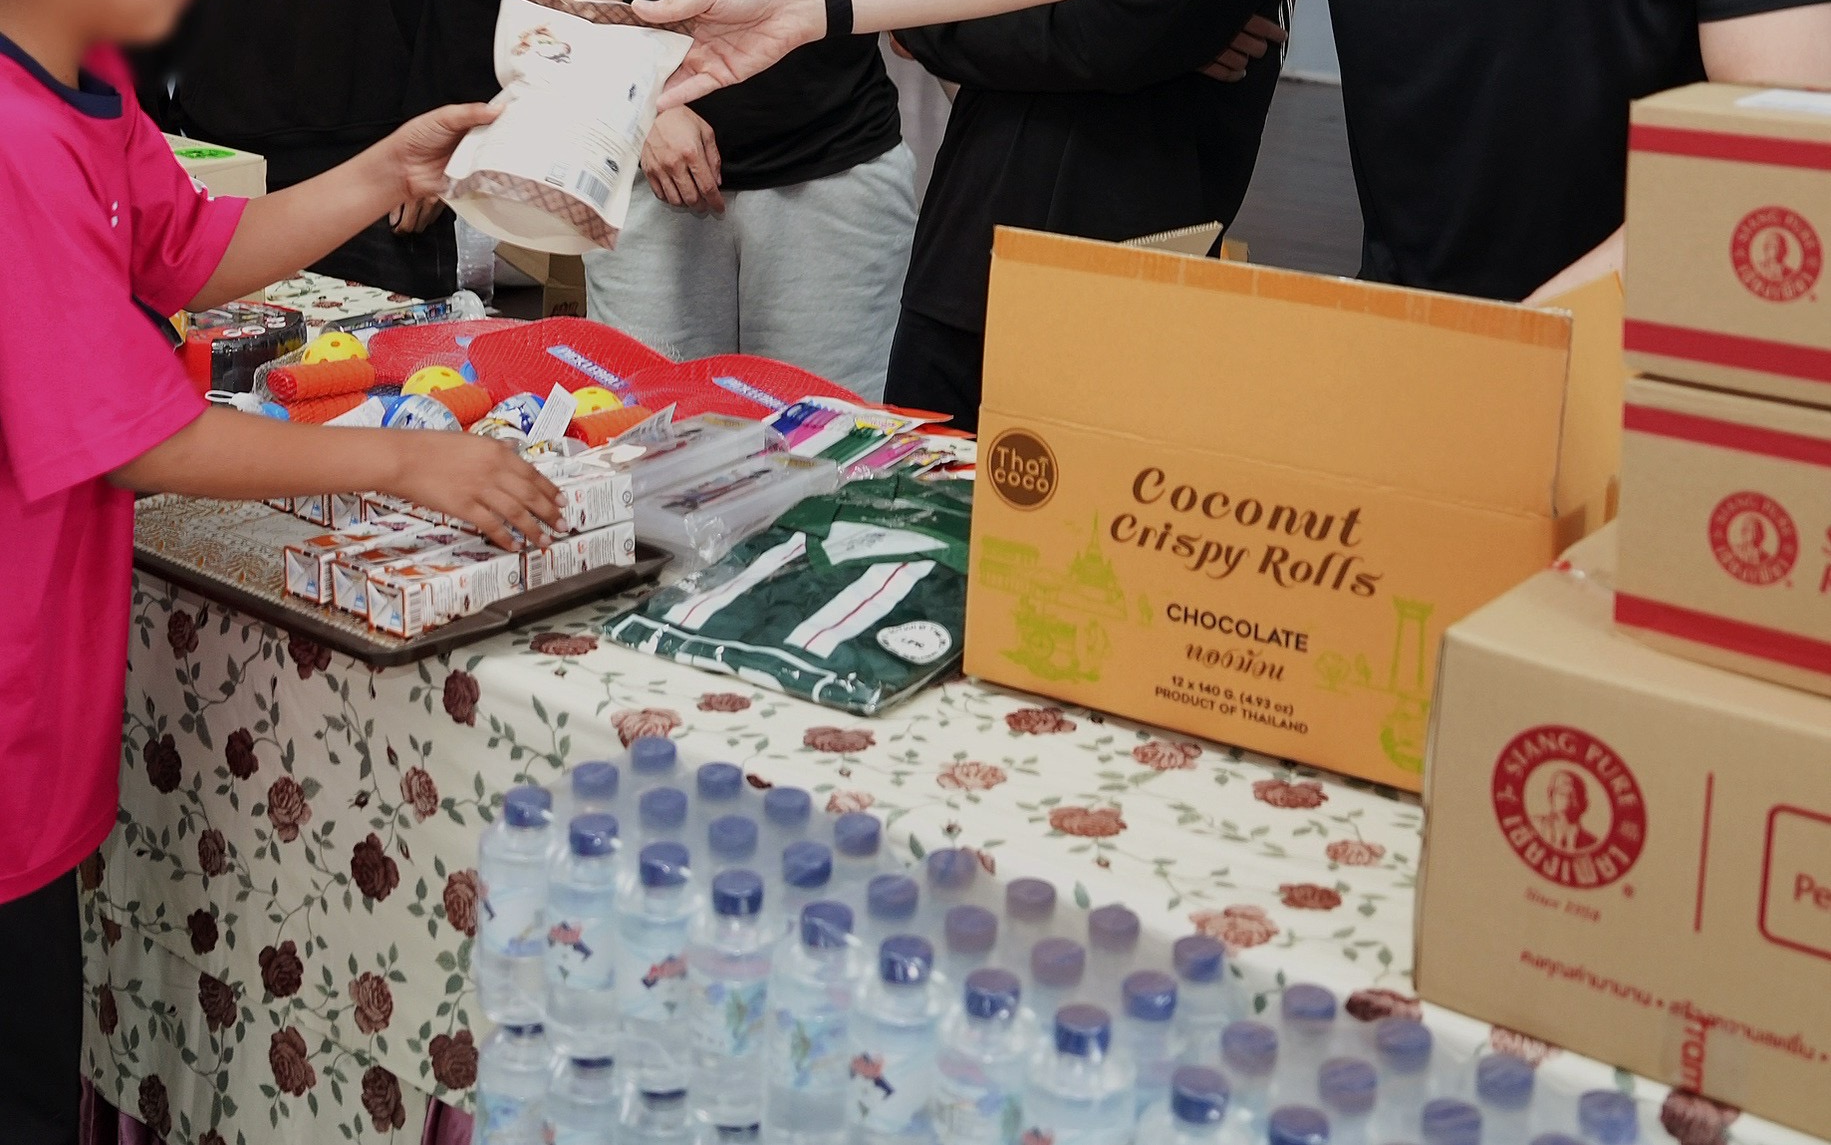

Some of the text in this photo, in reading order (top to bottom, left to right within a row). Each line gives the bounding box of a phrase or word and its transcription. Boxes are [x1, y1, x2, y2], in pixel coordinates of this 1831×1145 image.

[996, 446, 1049, 477] Thai
[1132, 467, 1361, 547] Coconut
[1110, 513, 1384, 597] Crispy Rolls
[1166, 603, 1309, 653] CHOCOLATE
[1155, 686, 1309, 735] PRODUCT OF THAILAND
[1172, 675, 1184, 688] 12
[1199, 682, 1221, 696] 140
[1503, 731, 1639, 806] SIANG PURE
